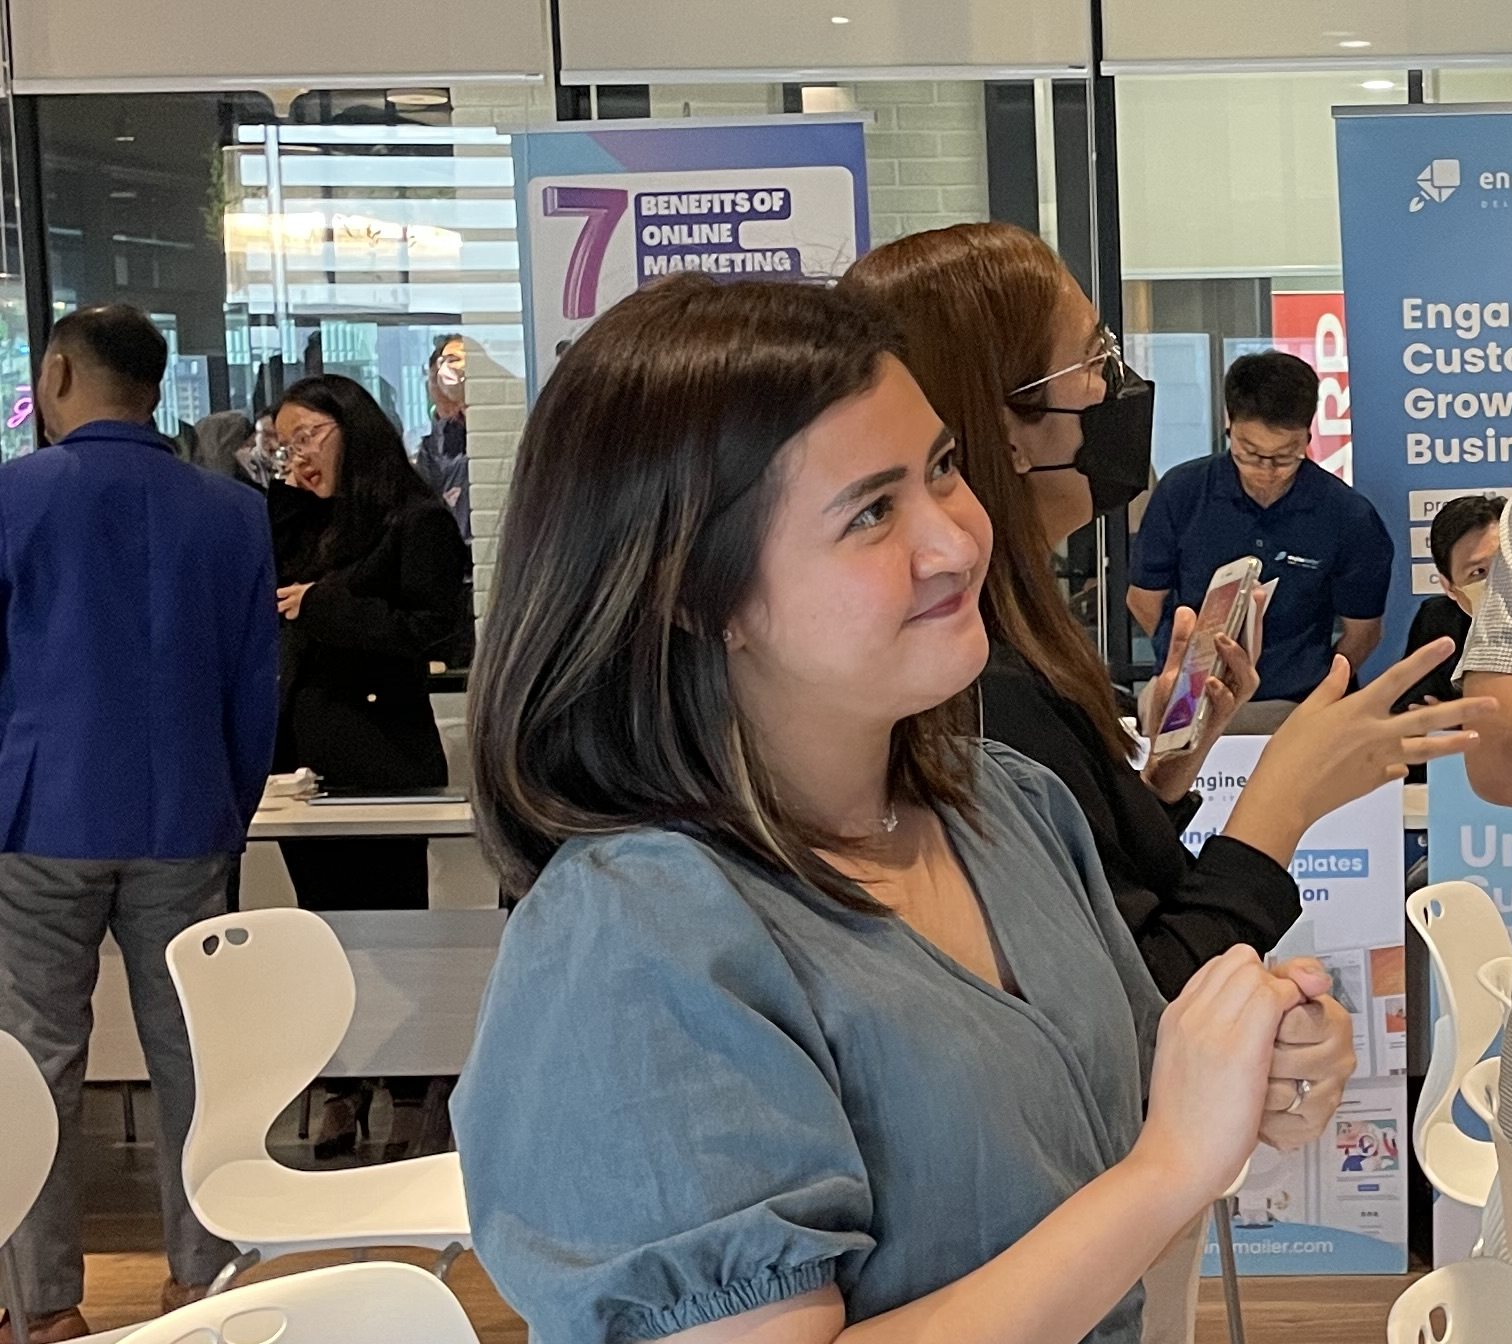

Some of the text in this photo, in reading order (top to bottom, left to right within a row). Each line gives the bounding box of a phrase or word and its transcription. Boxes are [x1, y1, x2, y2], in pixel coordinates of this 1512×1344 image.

[640, 191, 785, 216] BENEFITS OF
[642, 223, 733, 247] ONLINE
[542, 185, 629, 320] 7
[643, 250, 792, 277] MARKETING
[1294, 854, 1363, 878] plates
